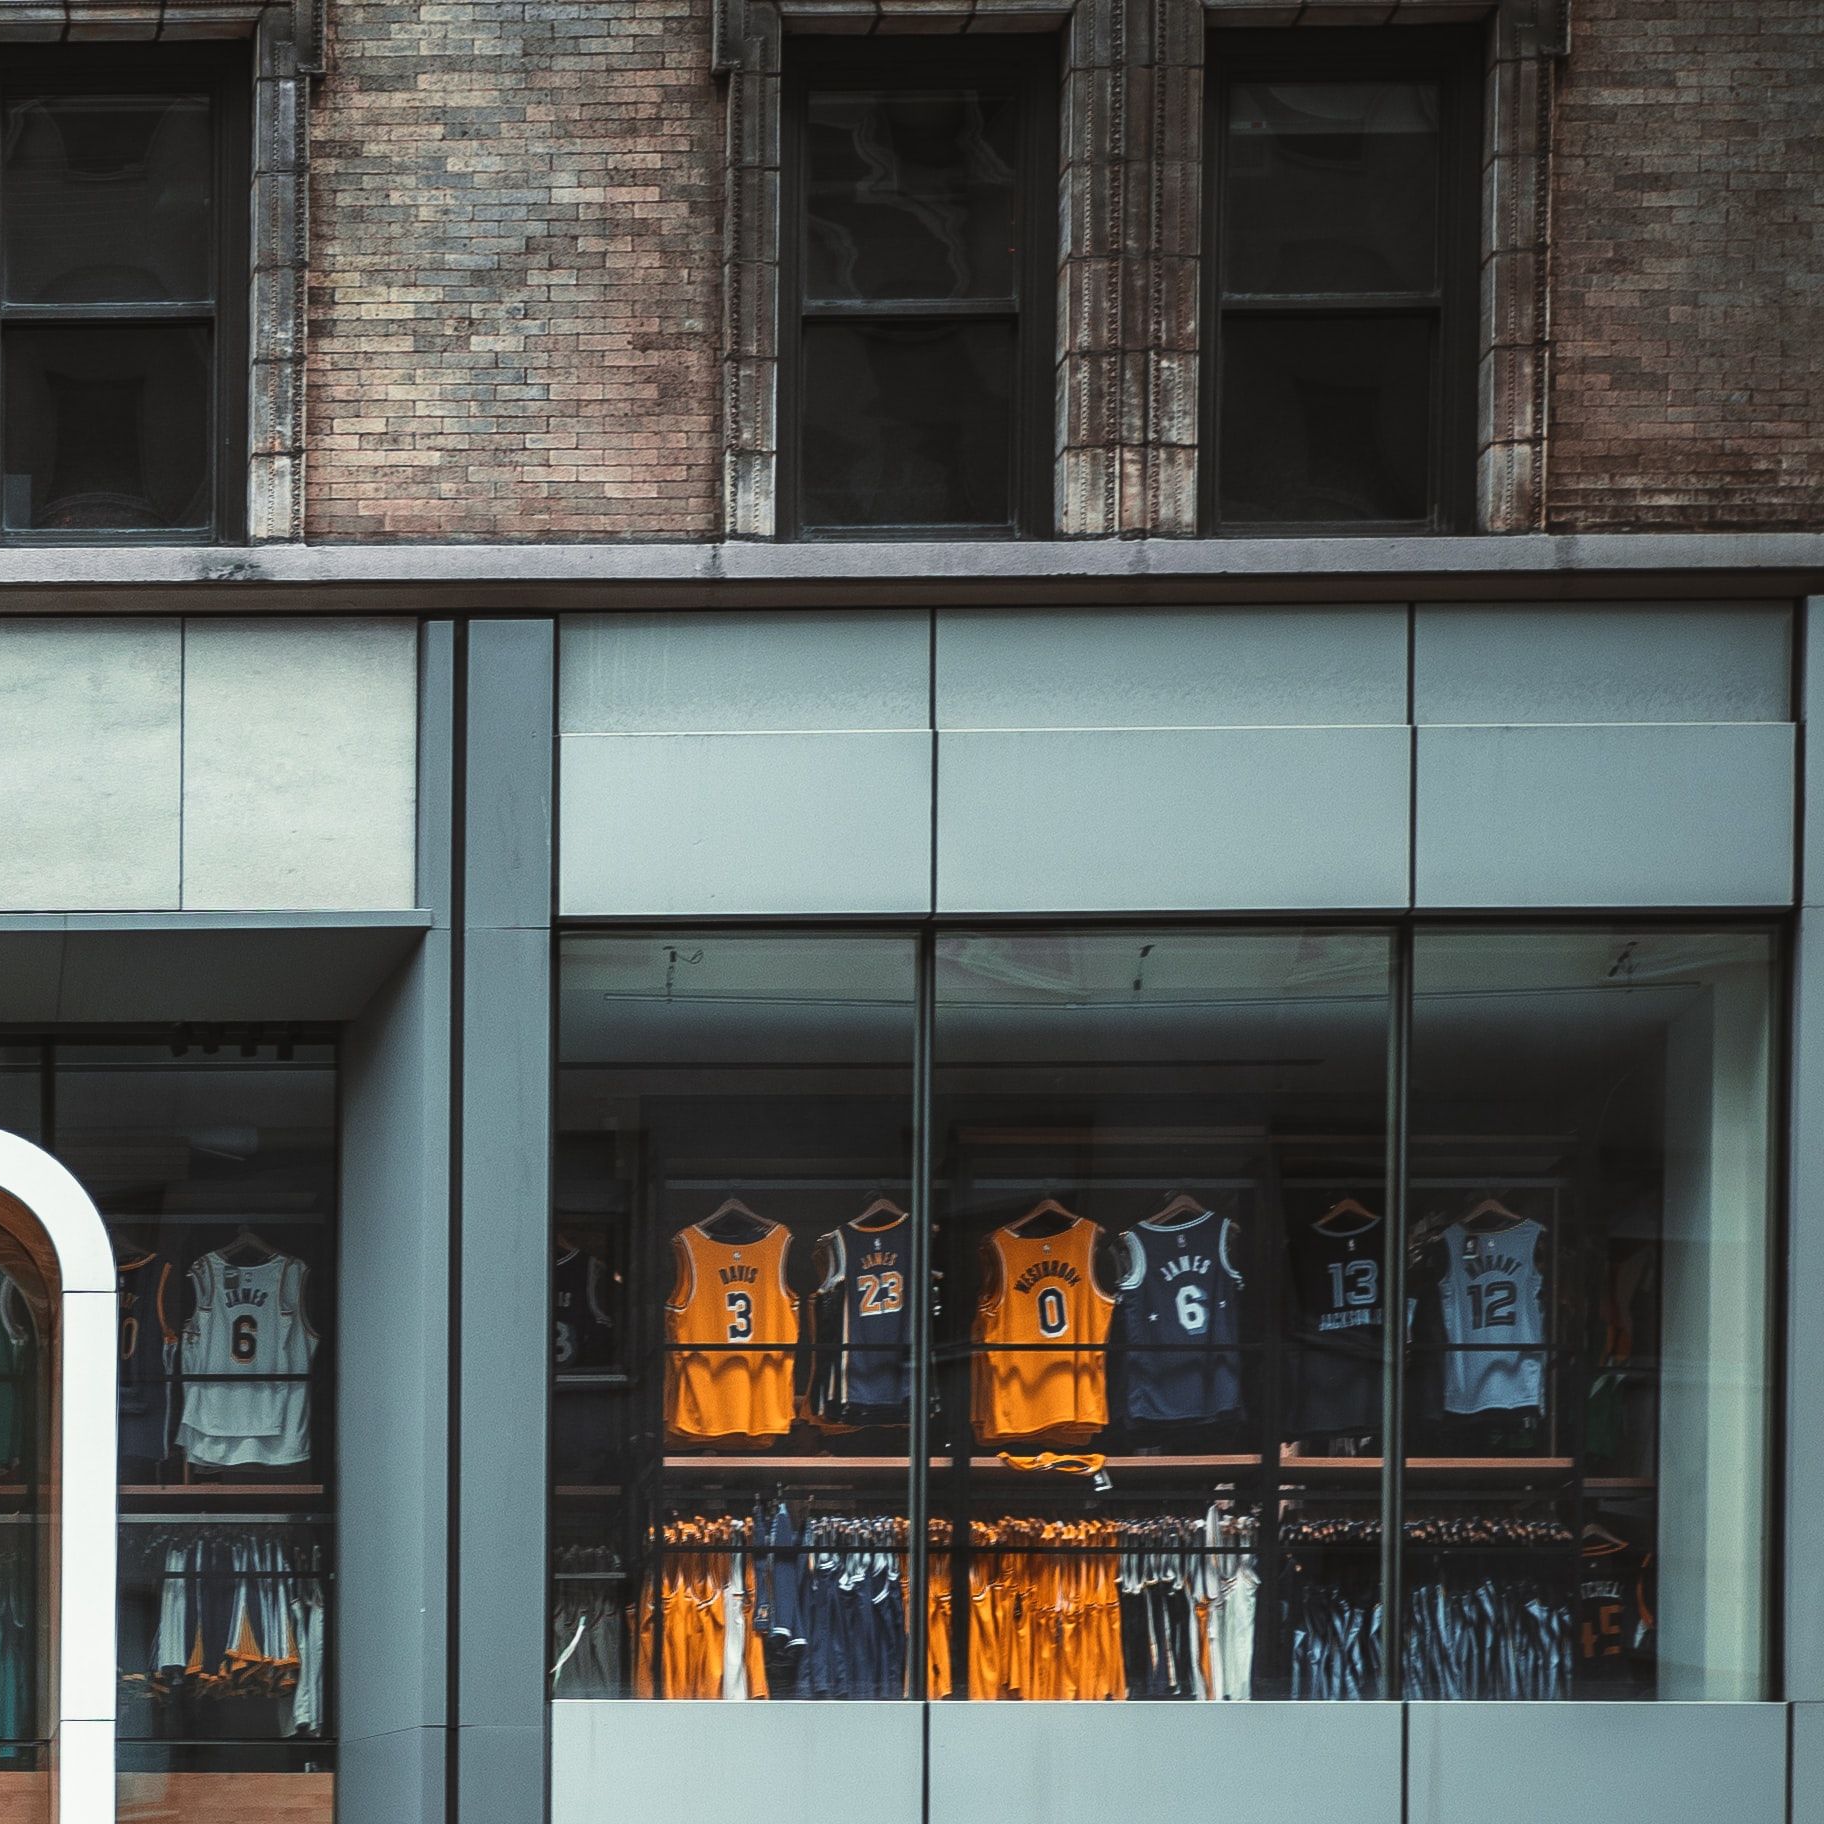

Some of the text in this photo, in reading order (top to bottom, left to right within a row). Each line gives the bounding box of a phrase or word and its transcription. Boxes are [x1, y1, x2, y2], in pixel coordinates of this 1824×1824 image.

[718, 1267, 758, 1285] DAVIS
[1159, 1255, 1211, 1282] JAMES
[1327, 1259, 1378, 1309] 13
[725, 1291, 753, 1343] 3
[857, 1271, 903, 1317] 23
[1036, 1286, 1069, 1338] 0
[1175, 1284, 1209, 1336] 6
[1467, 1280, 1517, 1330] 12
[230, 1314, 258, 1365] 6
